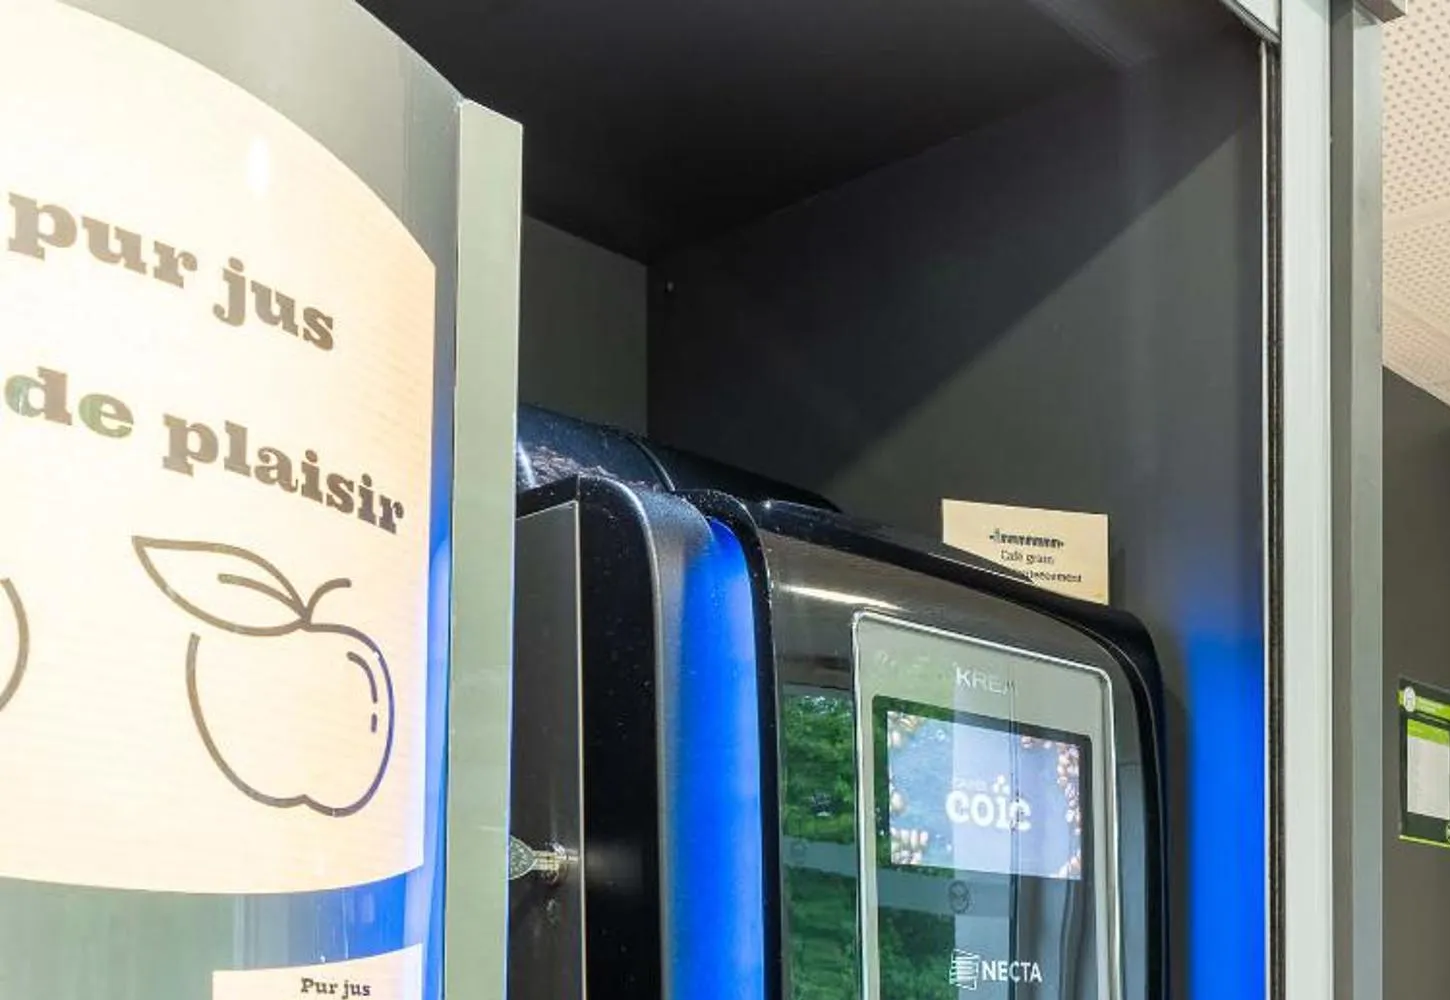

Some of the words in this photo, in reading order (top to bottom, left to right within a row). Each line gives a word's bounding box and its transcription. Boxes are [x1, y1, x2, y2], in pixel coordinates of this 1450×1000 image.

[6, 191, 198, 289] pur
[211, 256, 335, 352] jus
[3, 365, 135, 440] de
[162, 410, 405, 535] plaisir
[300, 977, 339, 996] Pur
[341, 979, 372, 1000] jus
[980, 960, 1043, 983] NECTA
